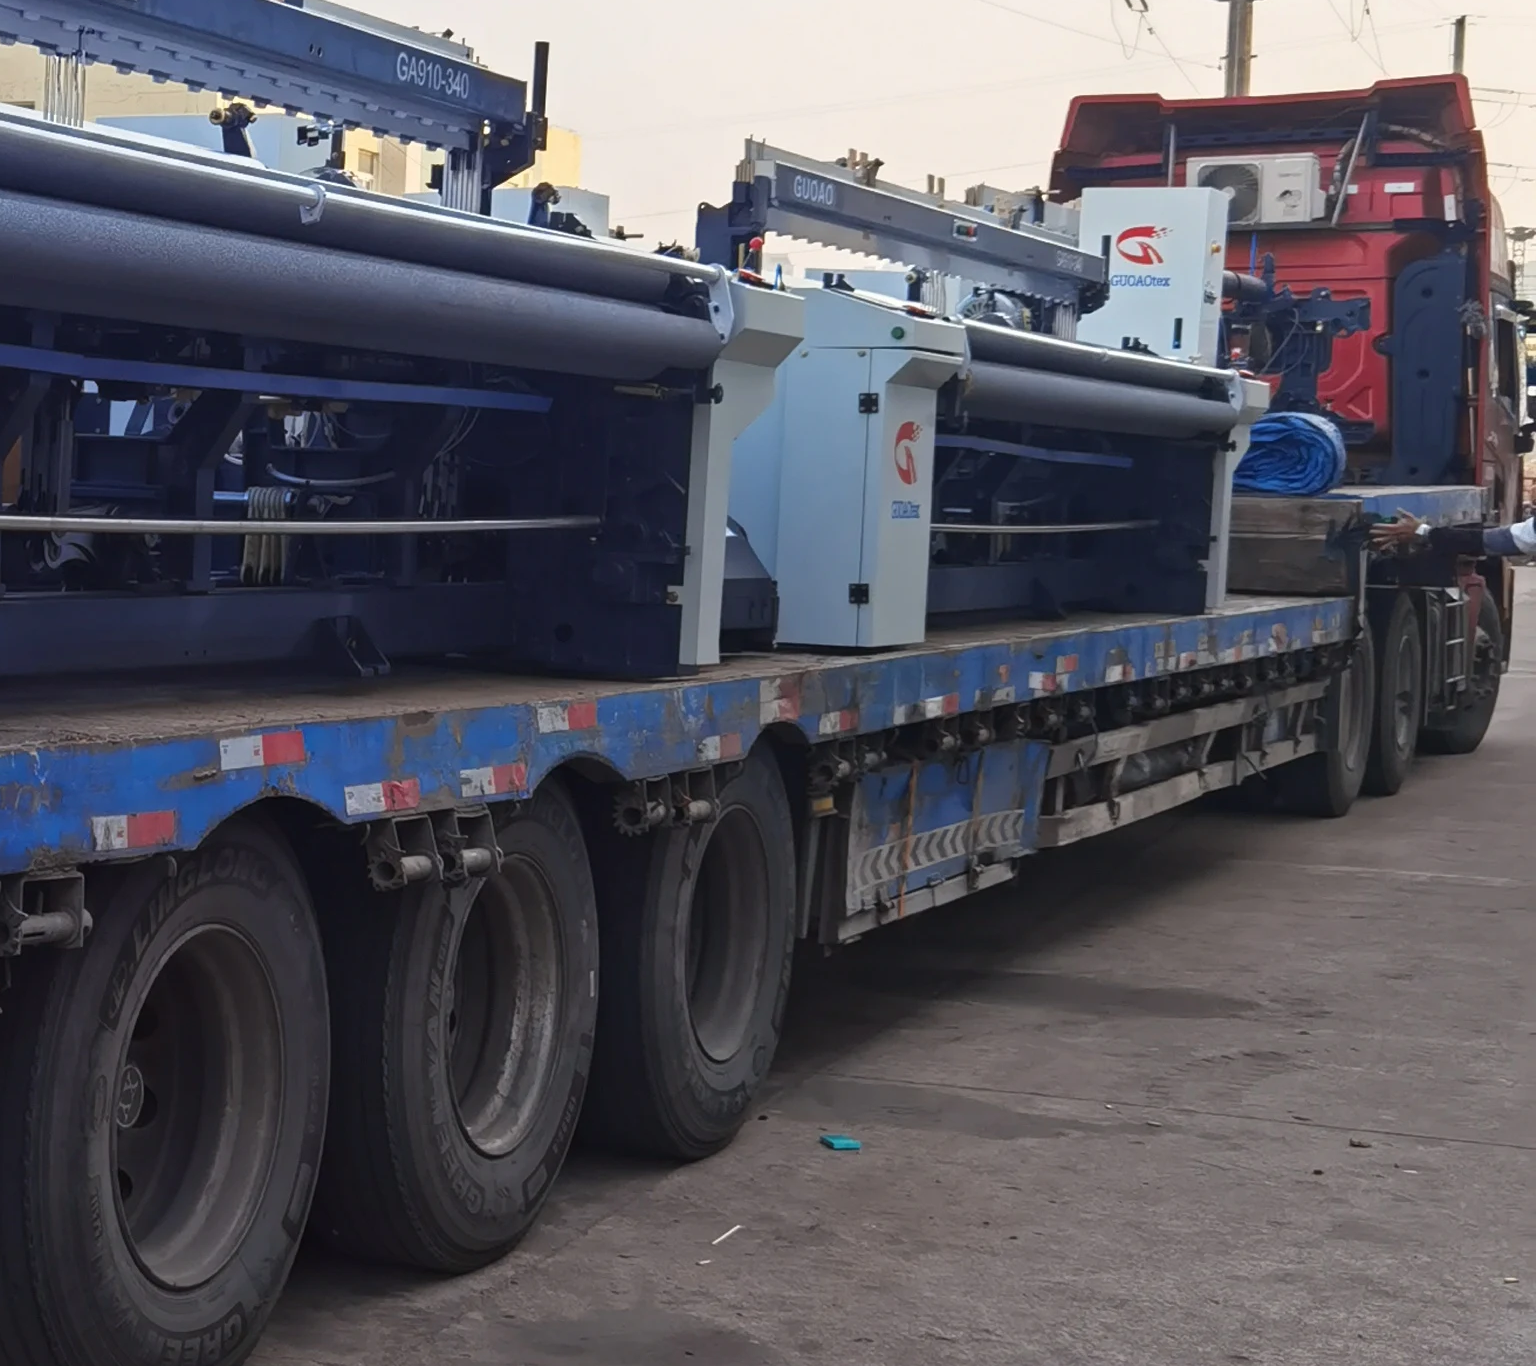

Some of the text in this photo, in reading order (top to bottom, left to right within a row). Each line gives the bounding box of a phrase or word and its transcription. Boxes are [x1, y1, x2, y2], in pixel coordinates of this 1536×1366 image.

[396, 51, 470, 100] GA910-340
[793, 174, 834, 207] GUOAO
[1110, 274, 1171, 287] GUOAOtex
